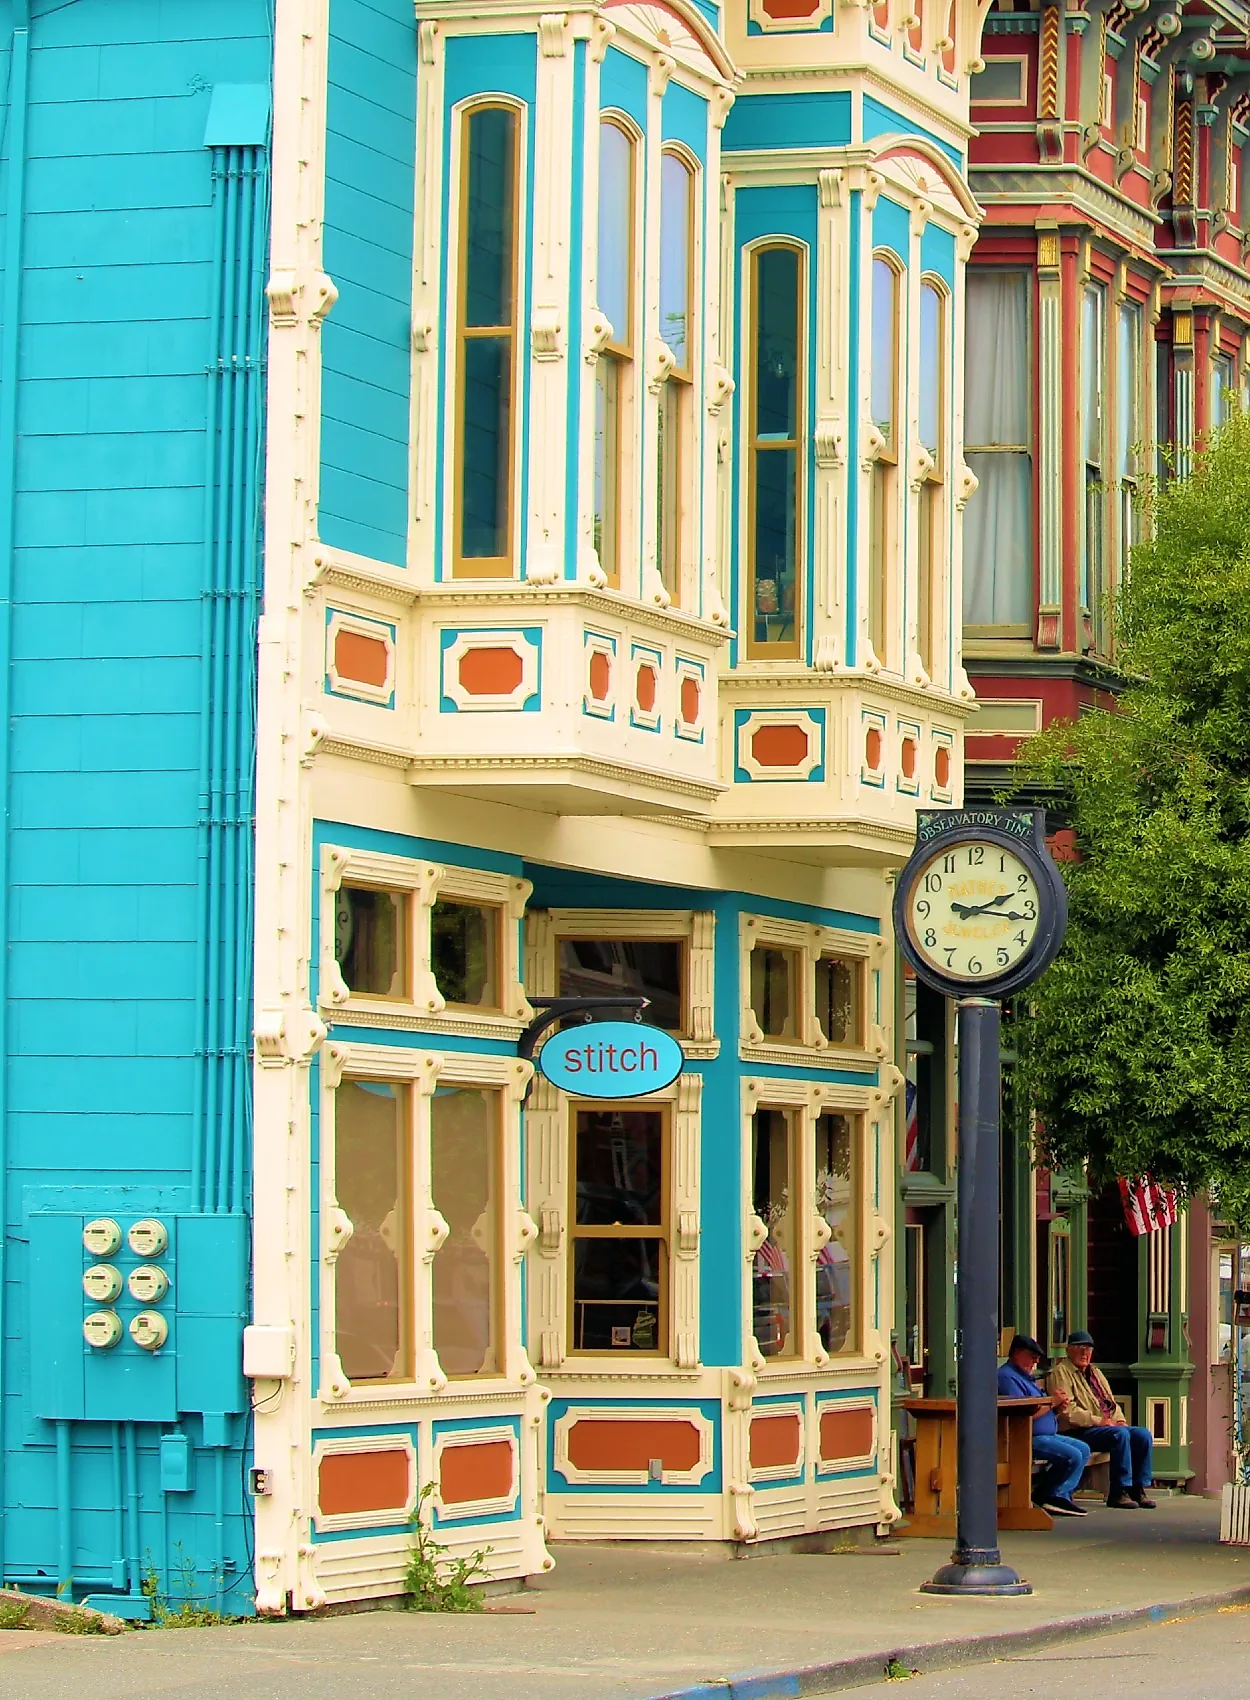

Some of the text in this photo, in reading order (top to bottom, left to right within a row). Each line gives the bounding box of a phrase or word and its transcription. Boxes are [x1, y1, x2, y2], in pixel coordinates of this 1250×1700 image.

[919, 812, 1002, 841] OBSERVATORY
[943, 854, 956, 873] 11
[968, 847, 984, 865] 12
[1000, 854, 1005, 872] 1
[924, 873, 942, 893] 10
[1017, 874, 1028, 893] 2
[916, 901, 931, 920] 9
[1023, 900, 1036, 920] 3
[924, 927, 937, 947] 8
[1013, 929, 1028, 947] 4
[943, 947, 957, 968] 7
[967, 955, 982, 974] 6
[996, 947, 1010, 967] 5
[564, 1041, 658, 1072] stitch
